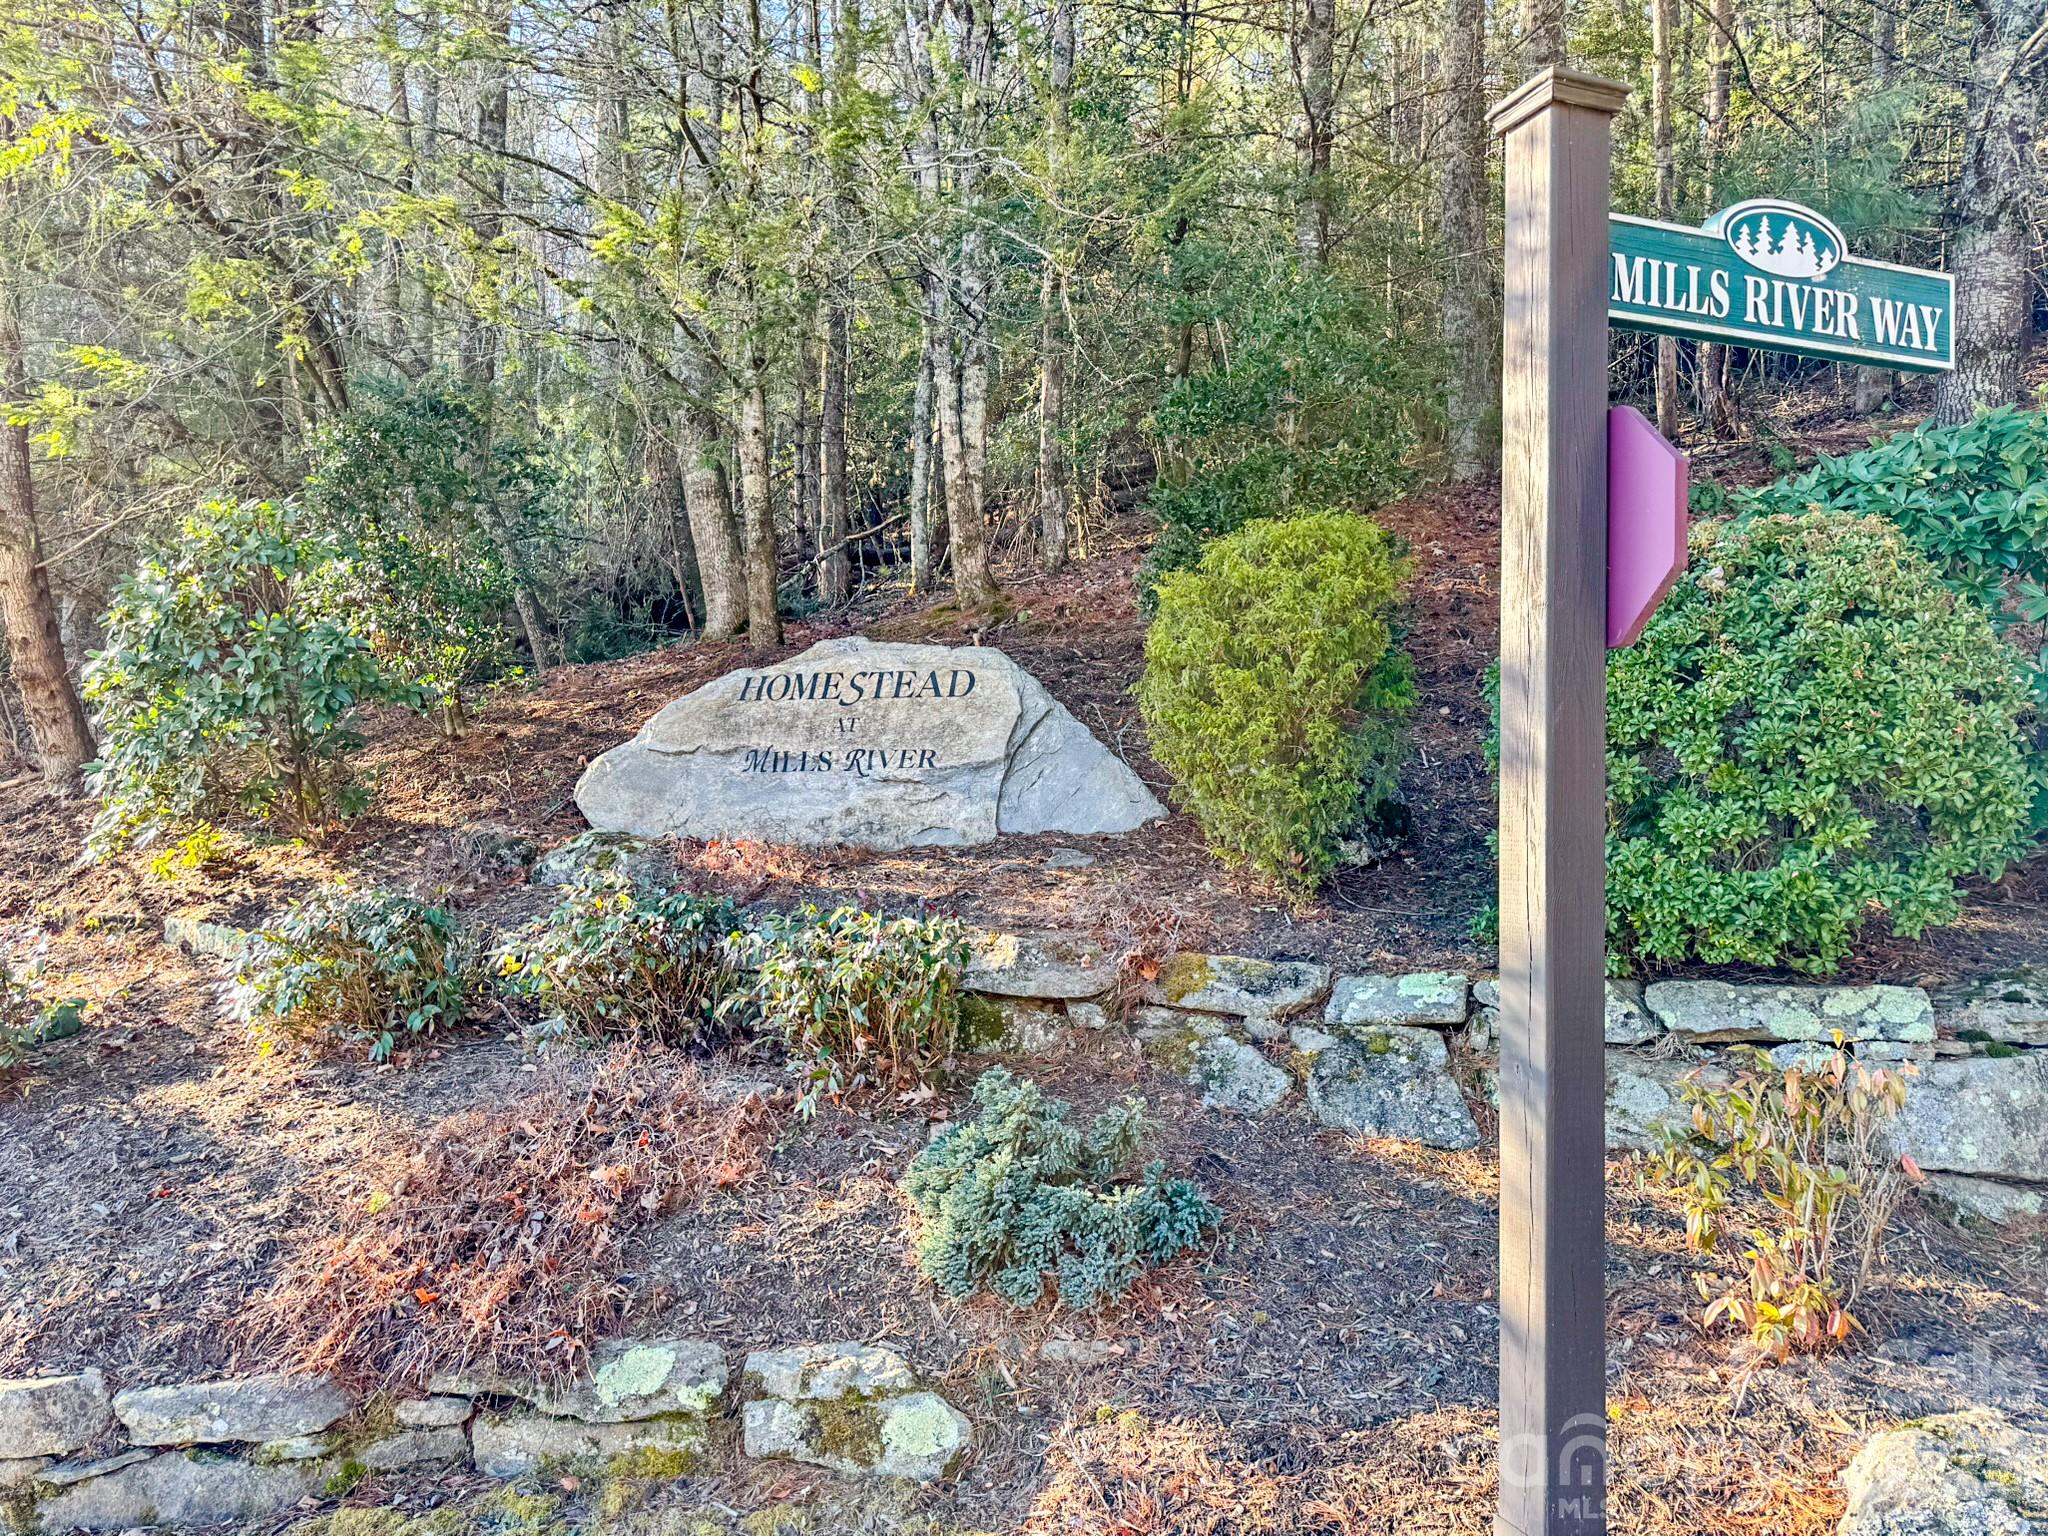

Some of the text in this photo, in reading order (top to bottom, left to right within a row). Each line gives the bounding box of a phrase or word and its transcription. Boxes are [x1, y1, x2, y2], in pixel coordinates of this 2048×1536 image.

[1611, 252, 1943, 352] MILLS RIVER WAY
[739, 669, 977, 707] HOMESTEAD
[832, 717, 860, 733] AT
[742, 744, 938, 778] MILLS RIVER
